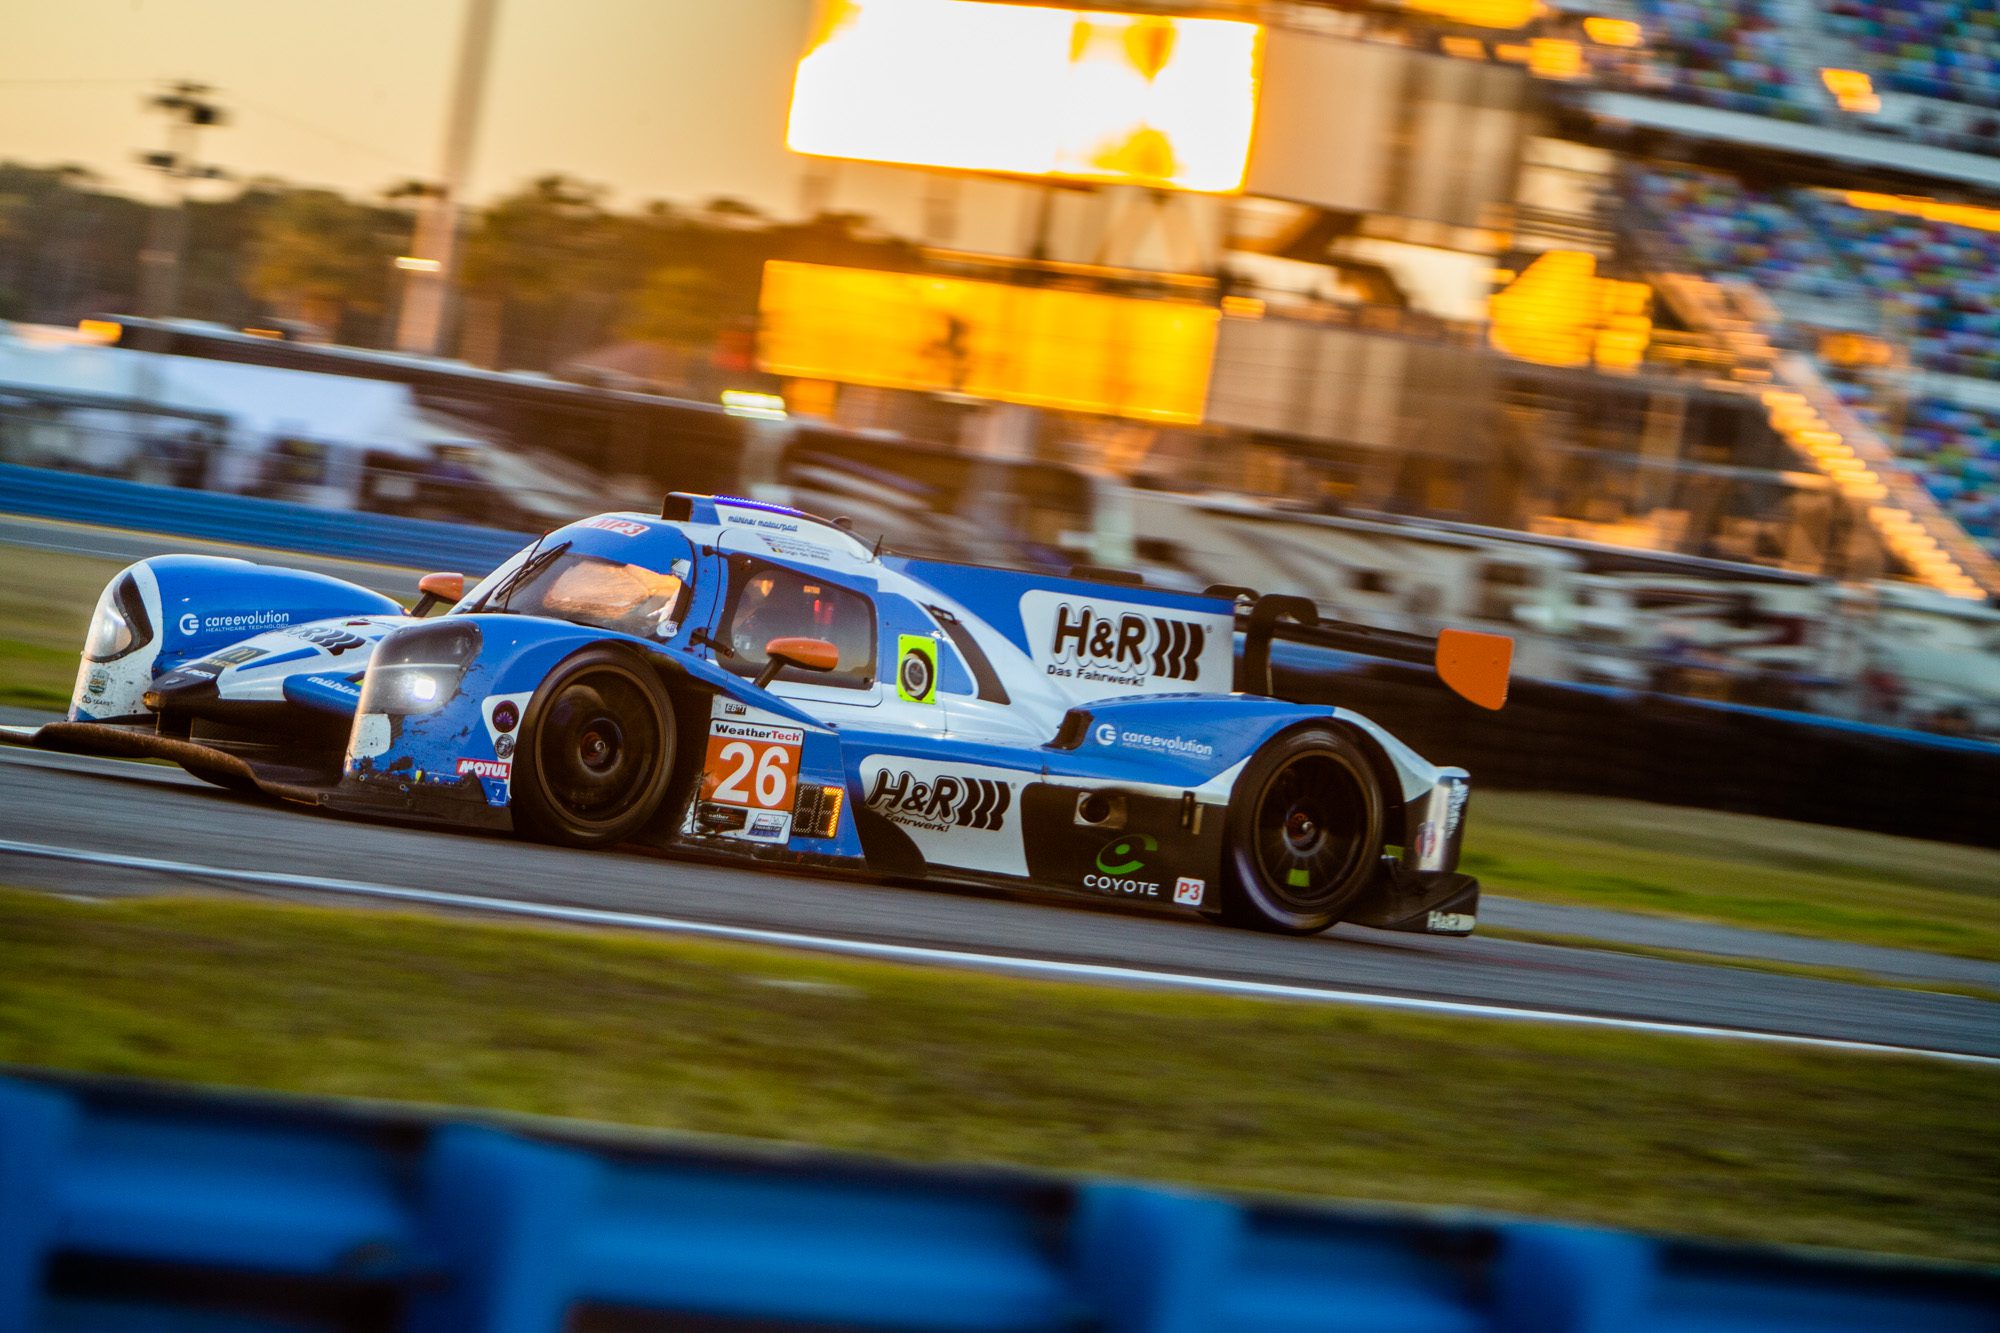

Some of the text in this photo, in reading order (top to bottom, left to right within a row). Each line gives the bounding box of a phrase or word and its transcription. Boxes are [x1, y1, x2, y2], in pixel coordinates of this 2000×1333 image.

[205, 610, 289, 627] careevolution
[1051, 604, 1150, 671] H&R
[1047, 664, 1145, 686] Das Fahrwerk!
[715, 723, 801, 742] WeatherTech
[1122, 731, 1213, 755] careevolution
[459, 760, 508, 777] MOTUL
[712, 741, 789, 807] 26
[866, 769, 961, 821] H&R
[885, 813, 951, 833] Fahrwerk!
[1083, 874, 1160, 896] COYOTE
[1177, 882, 1200, 901] P3
